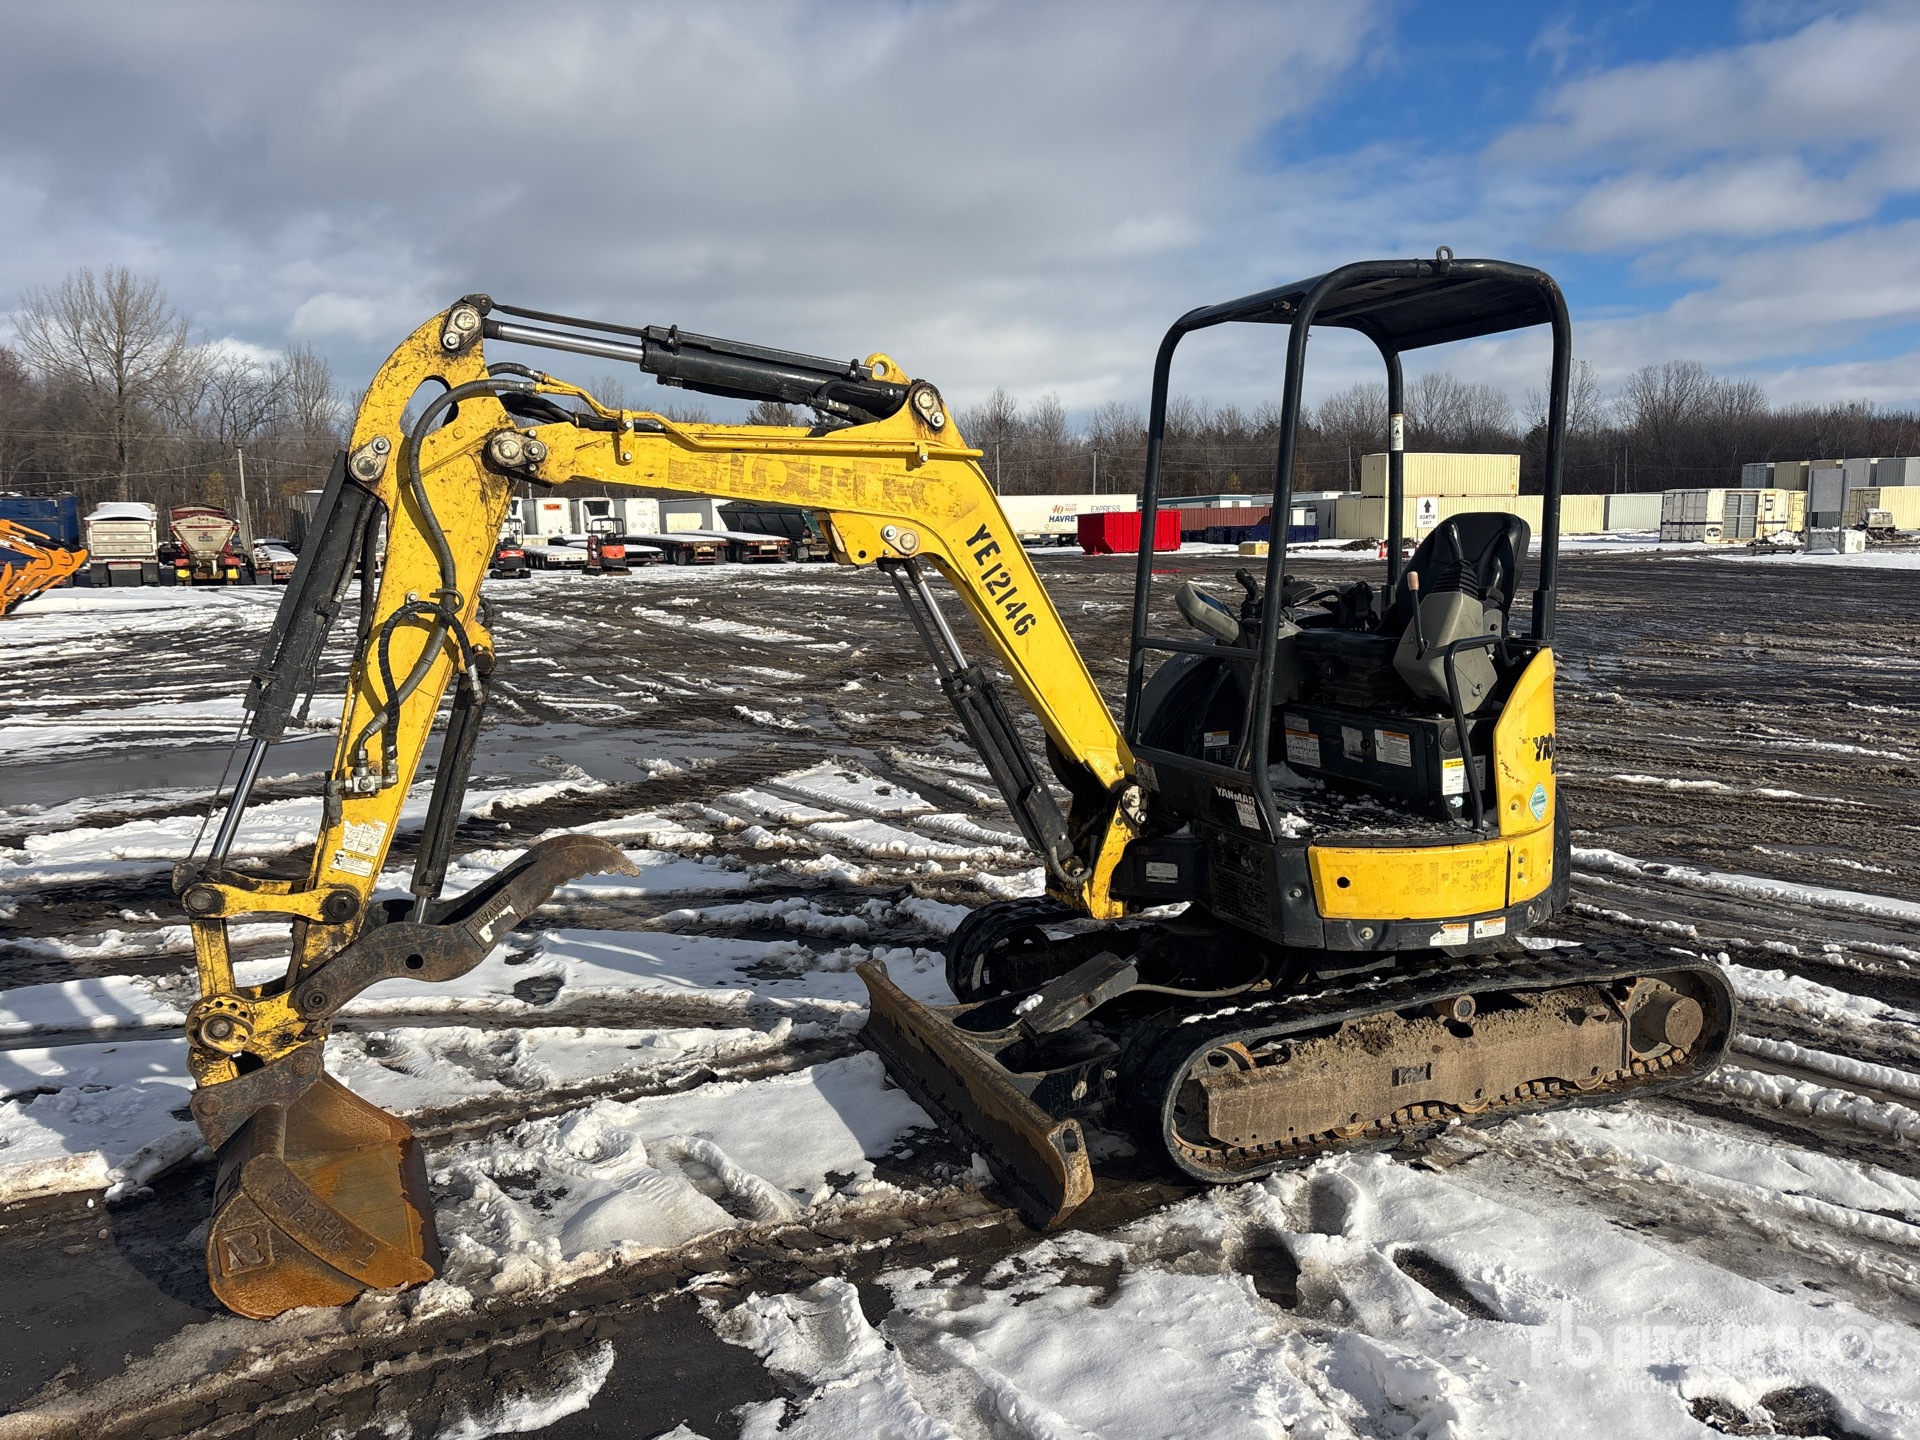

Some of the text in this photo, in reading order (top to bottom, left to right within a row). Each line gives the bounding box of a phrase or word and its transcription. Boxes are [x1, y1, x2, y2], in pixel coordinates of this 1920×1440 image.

[1090, 504, 1121, 513] EXPRESS
[1048, 515, 1076, 523] HAVRE
[965, 523, 1037, 636] YE12146
[1215, 786, 1256, 806] YANMAR
